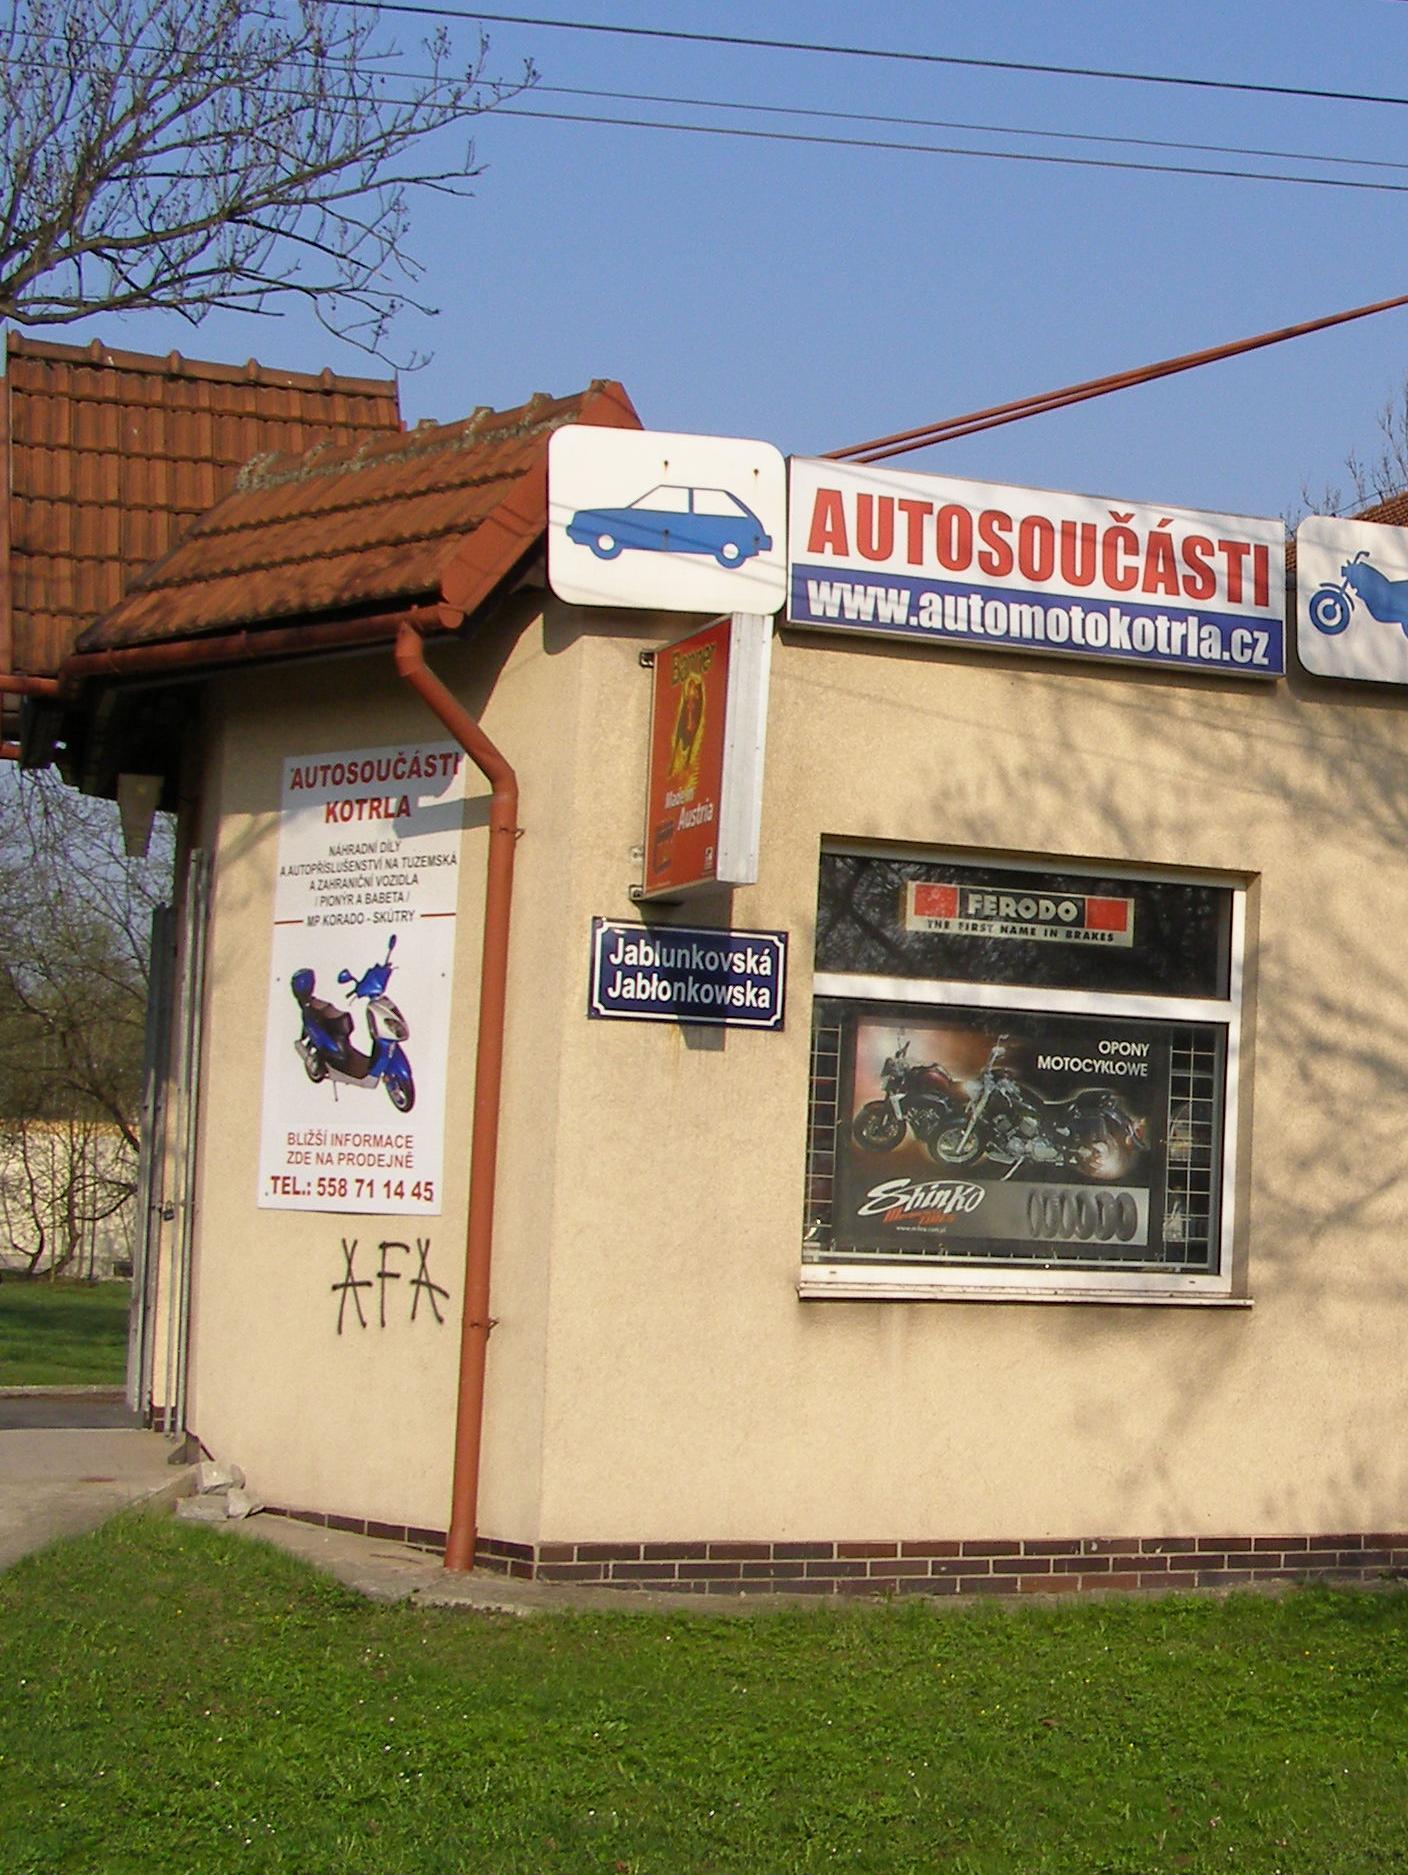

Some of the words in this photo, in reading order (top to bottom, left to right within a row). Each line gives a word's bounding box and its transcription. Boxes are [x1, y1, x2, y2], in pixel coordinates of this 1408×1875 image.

[807, 487, 1269, 608] AUTOSOUČÁSTI
[806, 579, 1270, 666] www.automotokotrla.cz
[289, 751, 459, 790] AUTOSOUČÁSTI
[325, 795, 412, 824] KOTRLA
[677, 798, 714, 831] Austria
[328, 841, 378, 857] NÁHRADNÍ
[380, 839, 402, 853] DÍLY
[287, 857, 383, 876] AUTOPŘÍSLUŠENSTVÍ
[385, 858, 399, 869] NA
[401, 853, 458, 869] TUZEMSKÁ
[309, 881, 316, 891] A
[317, 873, 374, 891] ZAHRANIČNÍ
[376, 873, 419, 888] VOZIDLA
[320, 893, 354, 907] PIONÝR
[357, 894, 363, 905] A
[365, 892, 404, 905] BABETA
[967, 893, 1079, 923] FERODO
[306, 915, 321, 927] MP
[323, 912, 364, 927] KORADO
[373, 907, 416, 924] SKÚTRY
[927, 919, 950, 930] THE
[958, 921, 995, 934] FIRST
[1000, 925, 1036, 937] NAME
[1044, 928, 1058, 938] IN
[1065, 931, 1115, 943] BRAKES
[608, 937, 772, 977] Jablunkovská
[607, 971, 771, 1010] Jabłonkowska
[1098, 1040, 1150, 1058] OPONY
[1037, 1055, 1149, 1078] MOTOCYKLOWE
[287, 1128, 327, 1146] BLIŽŠÍ
[330, 1133, 414, 1149] INFORMACE
[287, 1151, 312, 1165] ZDE
[315, 1152, 333, 1166] NA
[337, 1151, 414, 1168] PRODEJNĚ
[270, 1175, 311, 1196] TEL.:
[317, 1177, 348, 1197] 558
[355, 1178, 375, 1198] 71
[383, 1179, 405, 1199] 14
[411, 1181, 434, 1202] 45
